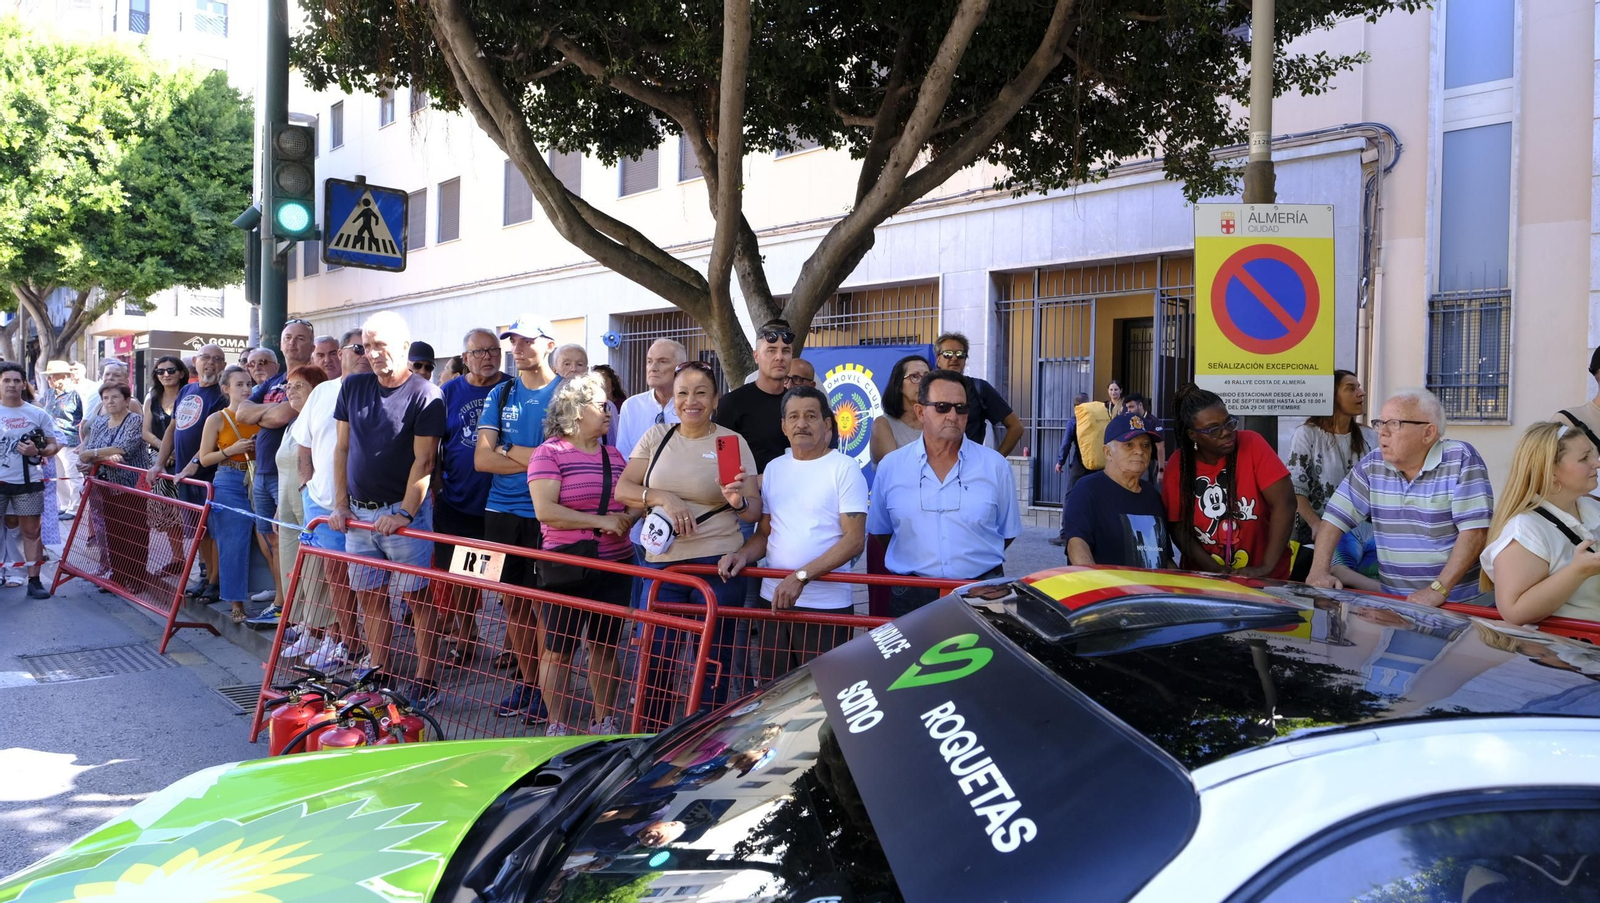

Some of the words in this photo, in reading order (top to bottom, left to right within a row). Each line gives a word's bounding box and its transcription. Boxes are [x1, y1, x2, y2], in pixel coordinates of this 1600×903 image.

[1247, 225, 1279, 233] CIUDAD
[1248, 210, 1308, 224] ALMERÍA
[1207, 361, 1264, 370] SEÑALIZACIÓN
[1266, 362, 1319, 370] EXCEPCIONAL
[827, 374, 861, 389] OMOVIL
[864, 382, 880, 410] CLUB
[837, 680, 884, 734] sano
[920, 700, 1038, 853] ROQUETAS
